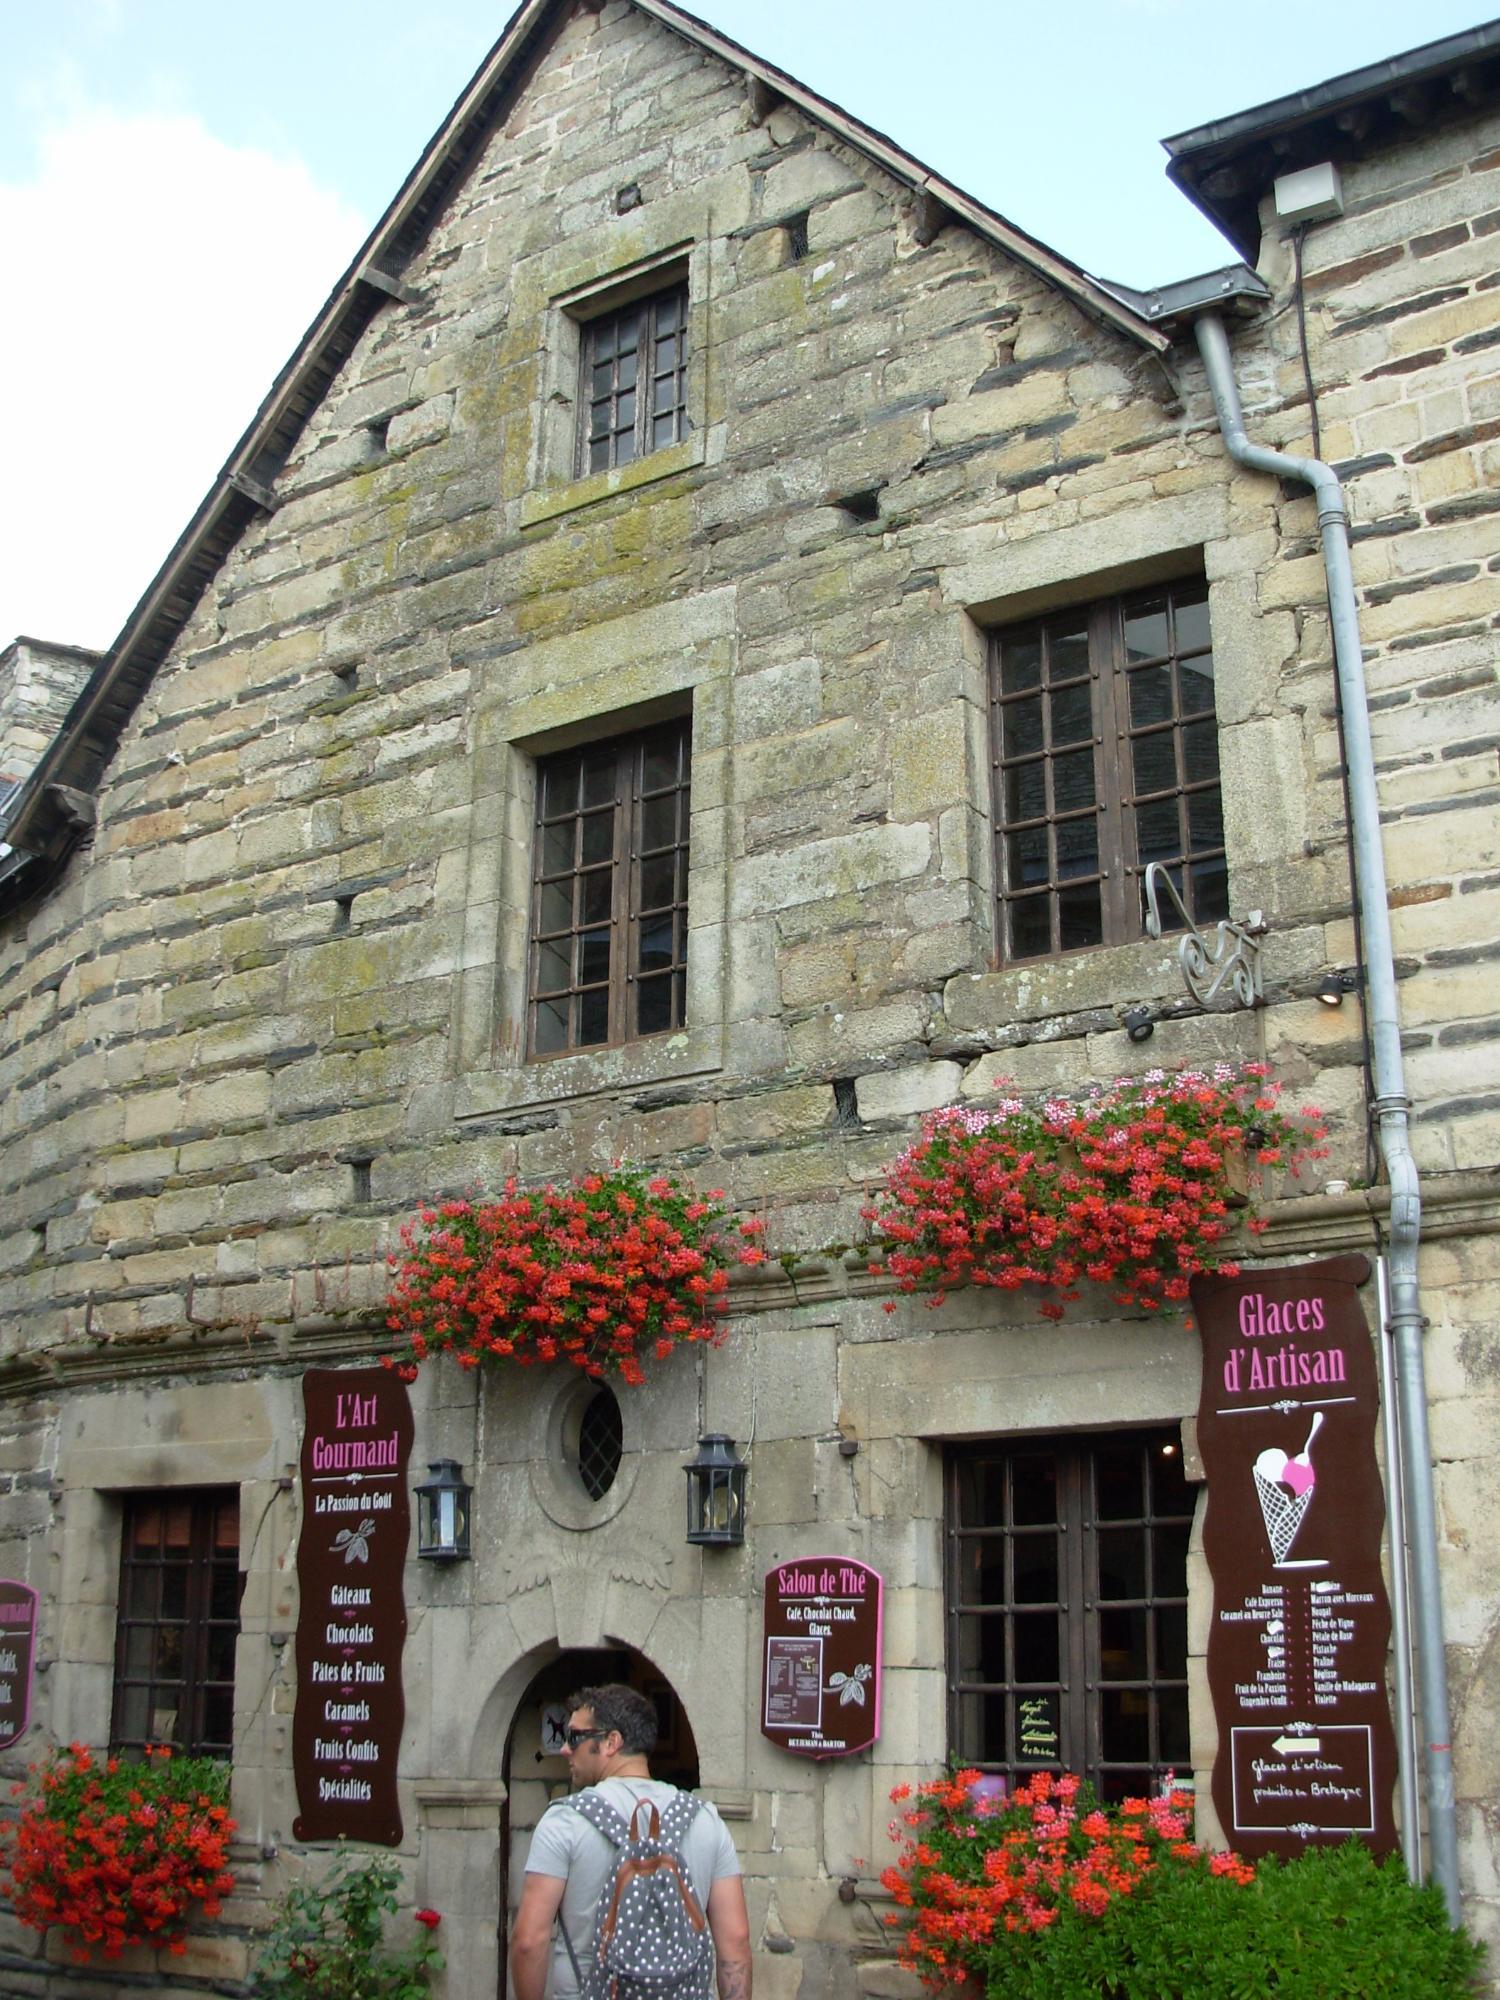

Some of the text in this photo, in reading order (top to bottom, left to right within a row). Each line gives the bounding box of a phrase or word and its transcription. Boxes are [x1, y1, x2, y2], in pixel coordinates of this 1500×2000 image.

[1239, 1293, 1325, 1337] Glaces
[1223, 1343, 1347, 1392] d'Artisan
[336, 1393, 377, 1428] L'Art
[313, 1430, 399, 1470] Gourmand
[315, 1491, 392, 1513] La Passion du Goût
[778, 1567, 866, 1594] Salon de Thé
[331, 1584, 371, 1605] Gâteaux
[786, 1606, 857, 1622] Café, Chocolat Chaud,
[326, 1622, 374, 1644] Chocolats
[312, 1660, 385, 1682] Pâtes de Fruits
[325, 1699, 370, 1721] Caramels
[315, 1737, 379, 1761] Fruits Confits
[1251, 1757, 1343, 1782] Glaces d'artisan
[319, 1776, 372, 1802] Spécialités
[1253, 1781, 1362, 1804] produites en Bretagne
